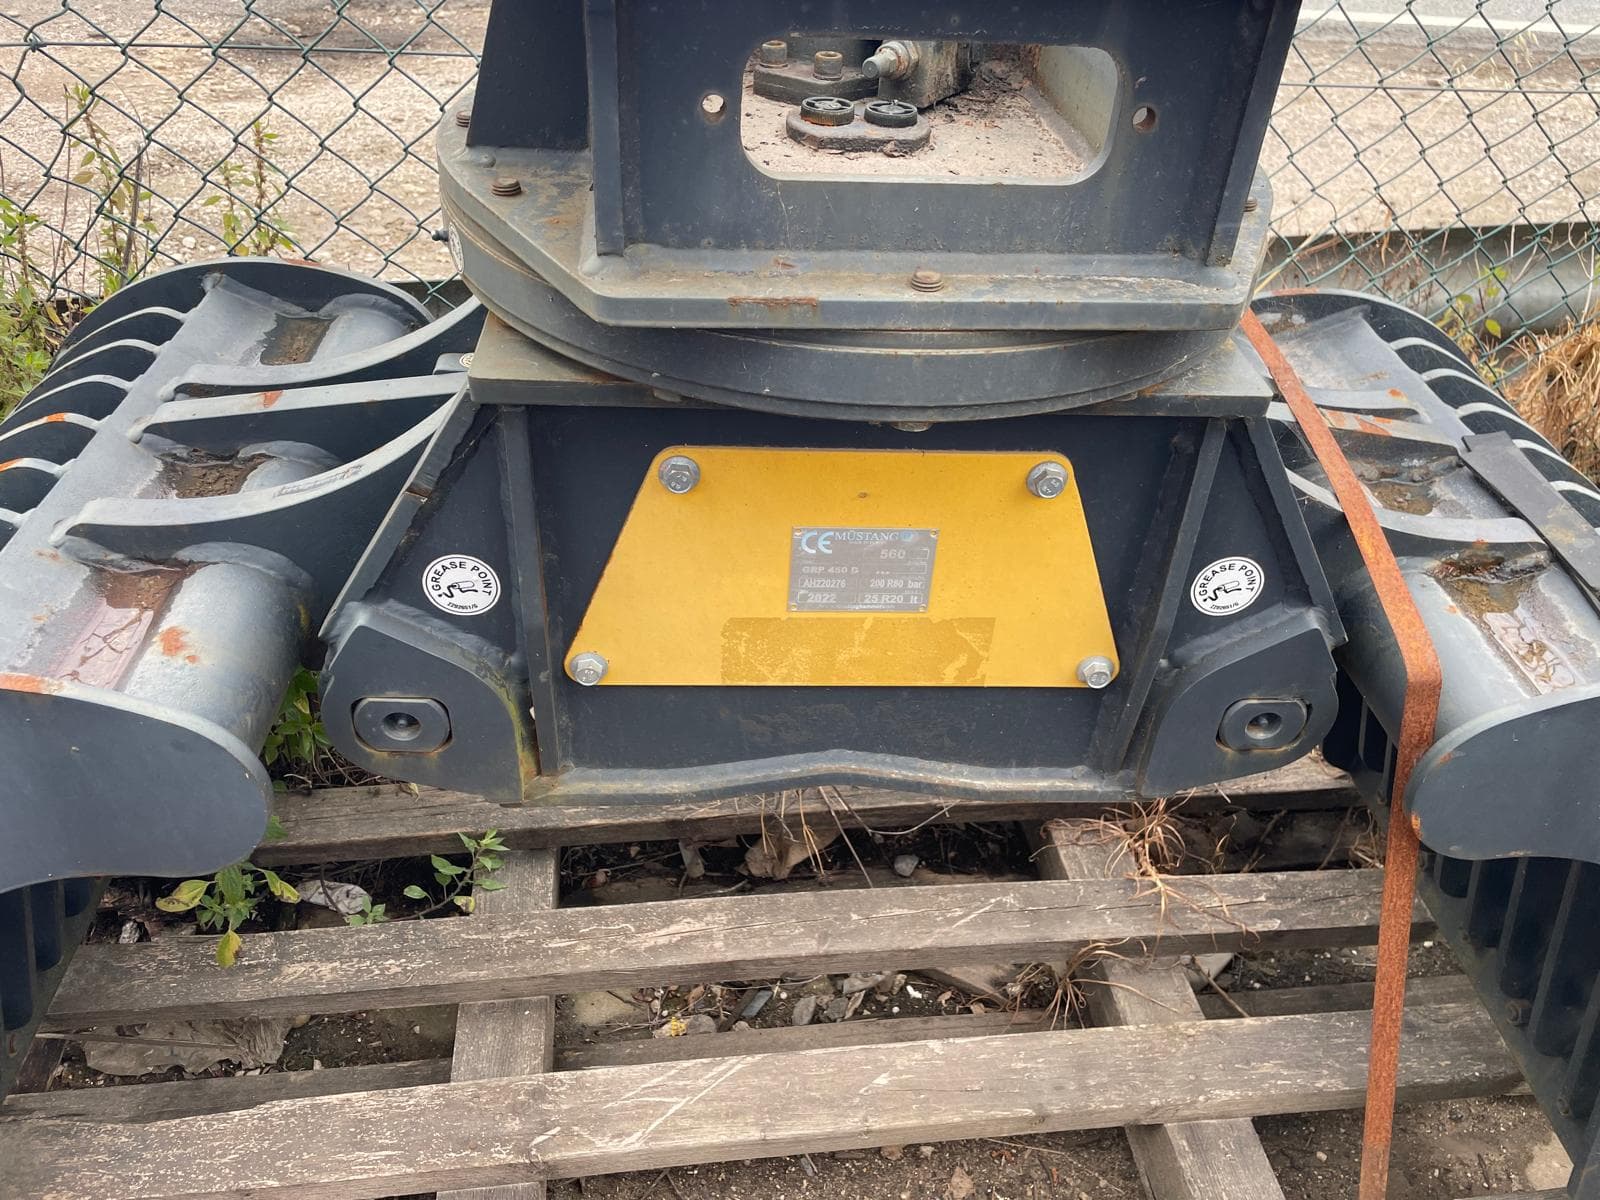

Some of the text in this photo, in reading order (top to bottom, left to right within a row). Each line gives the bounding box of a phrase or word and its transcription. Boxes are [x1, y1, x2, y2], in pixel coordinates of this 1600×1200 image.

[801, 531, 833, 554] CE
[880, 549, 906, 559] 560
[431, 561, 493, 596] GREASE POINT
[1198, 563, 1257, 596] GREASE POINT
[907, 579, 923, 589] bar
[807, 593, 837, 603] 2022
[863, 594, 880, 603] 25
[881, 594, 904, 603] R20
